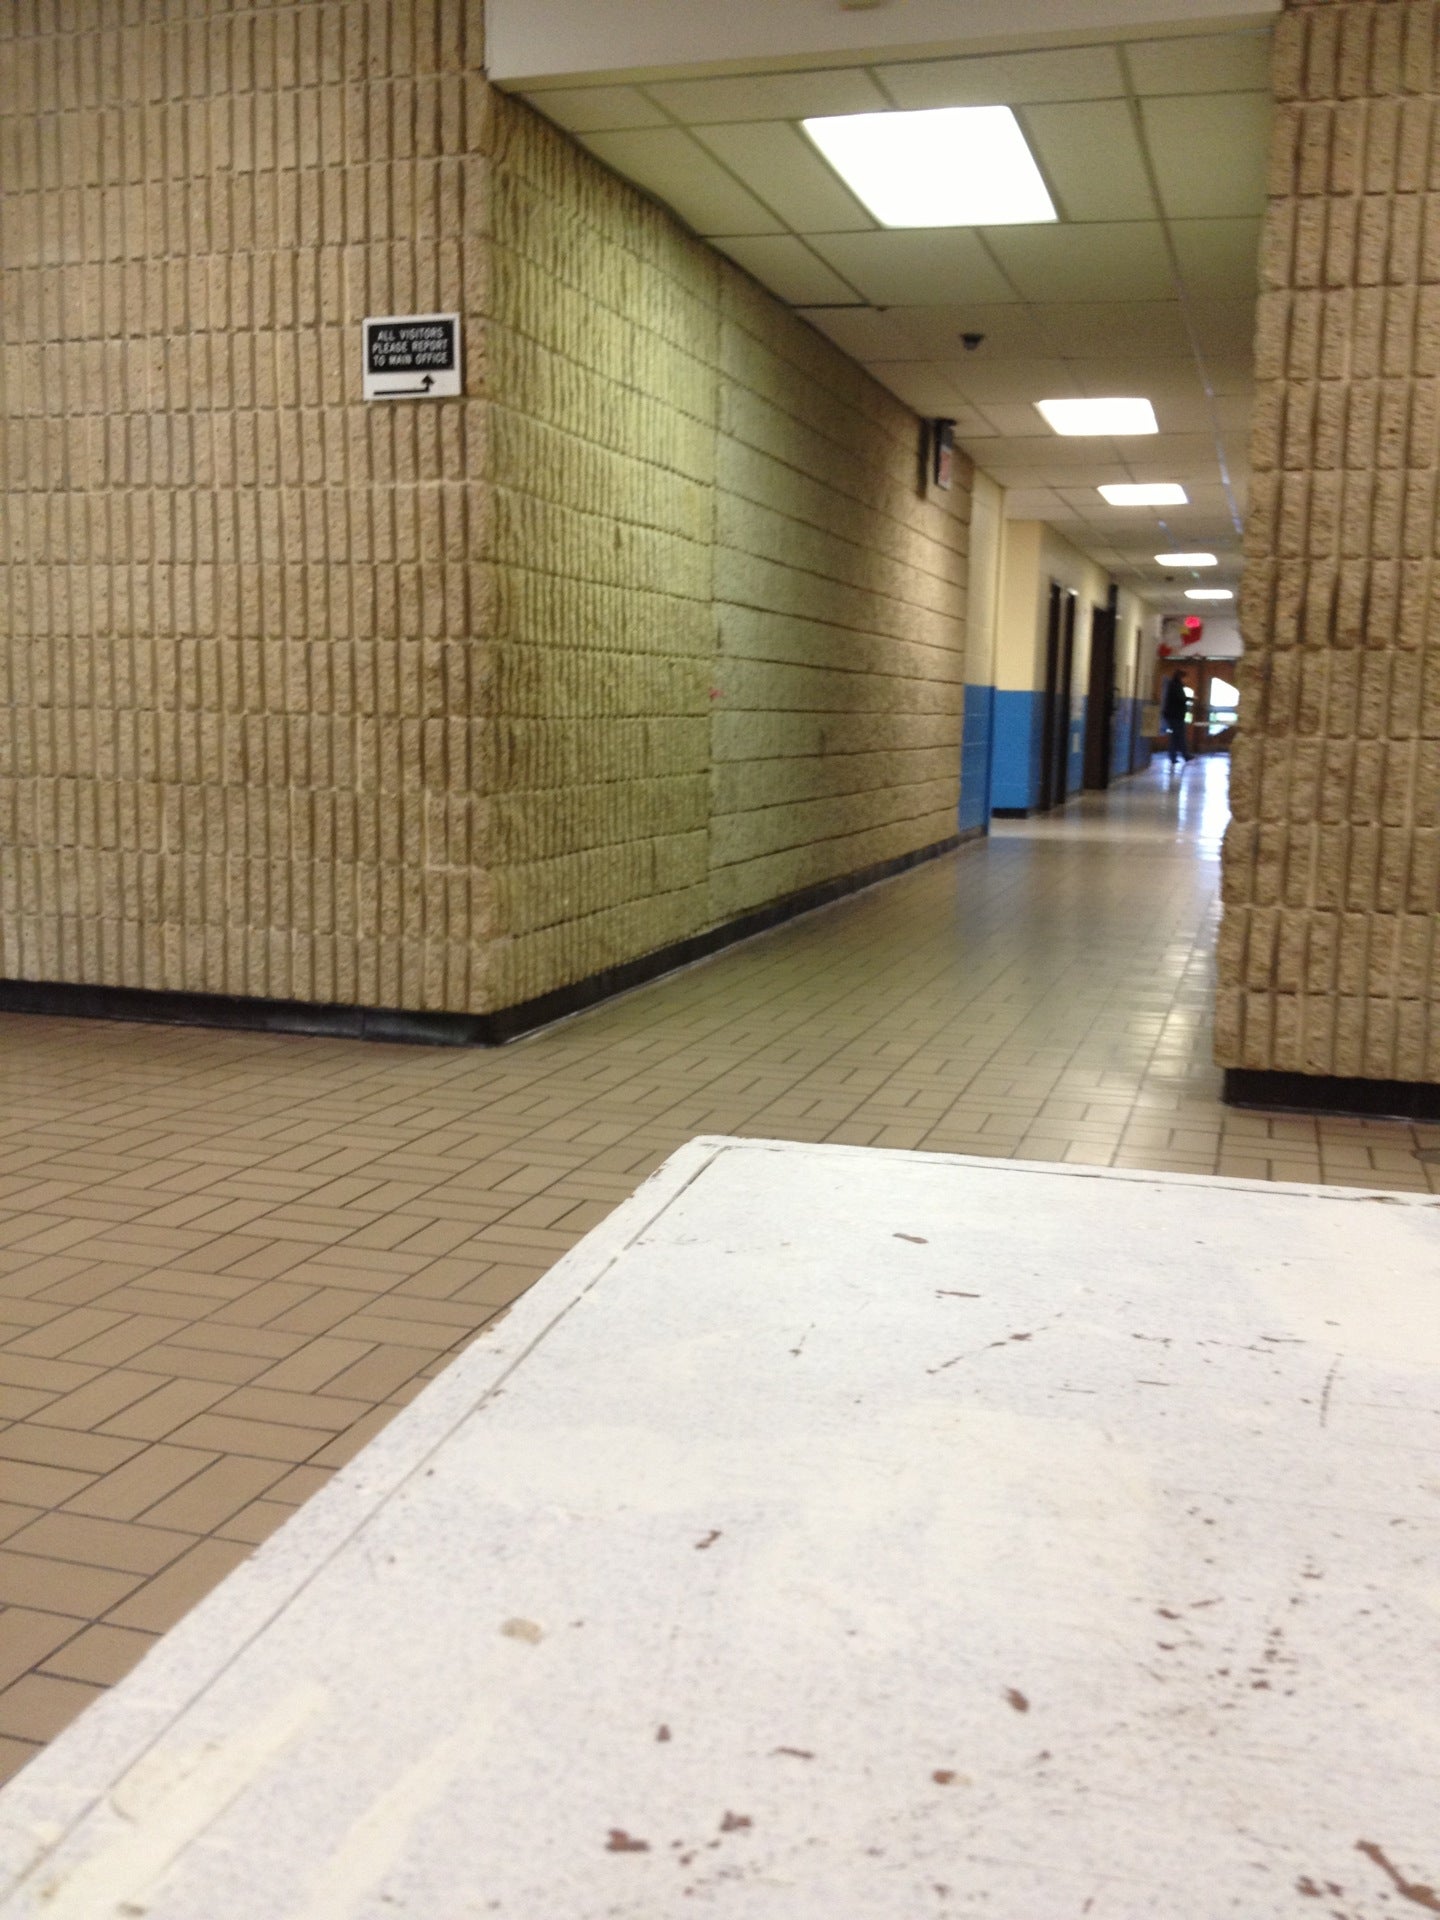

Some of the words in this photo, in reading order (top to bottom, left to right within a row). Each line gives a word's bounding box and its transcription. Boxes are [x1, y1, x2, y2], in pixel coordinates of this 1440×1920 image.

[377, 330, 396, 342] ALL
[399, 326, 444, 340] VISITORS
[372, 341, 408, 355] PLEASE
[411, 338, 448, 352] REPORT
[373, 354, 386, 367] TO
[388, 354, 413, 366] MAIN
[415, 351, 448, 366] OFFICE
